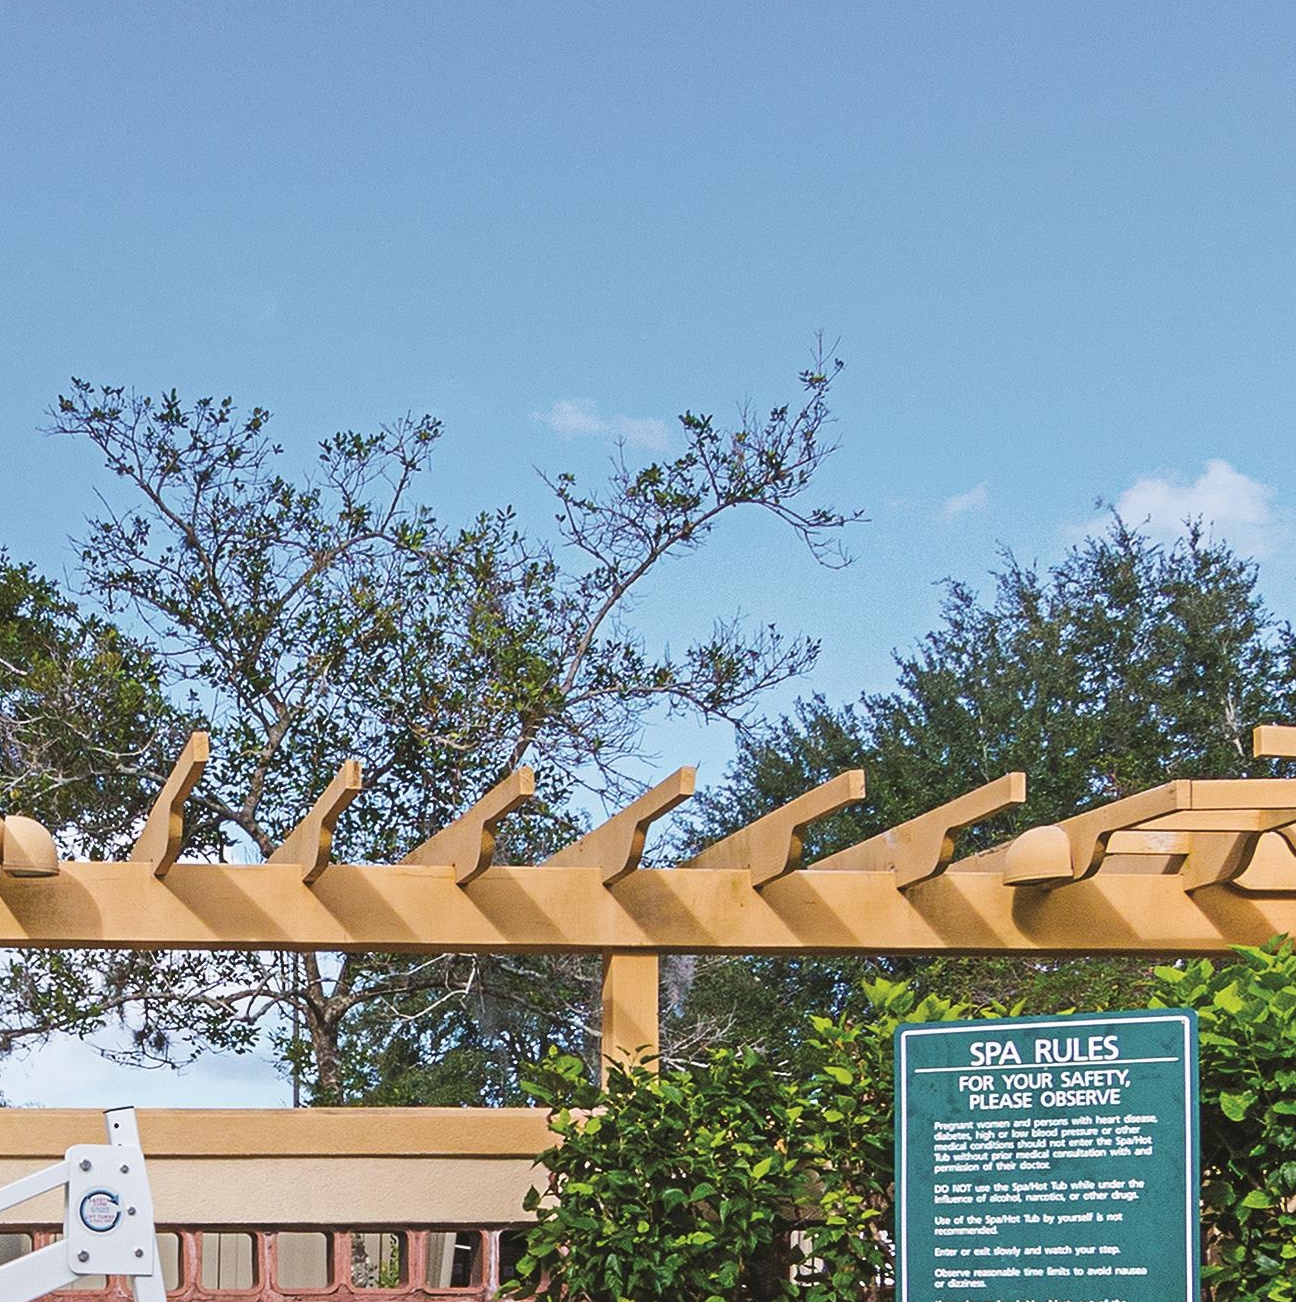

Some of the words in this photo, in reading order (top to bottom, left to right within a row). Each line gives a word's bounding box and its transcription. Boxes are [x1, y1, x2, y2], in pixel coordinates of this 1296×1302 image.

[969, 1040, 1022, 1067] SPA
[1034, 1035, 1119, 1064] RULES
[958, 1075, 995, 1092] FOR
[1001, 1072, 1053, 1090] YOUR
[1060, 1068, 1131, 1088] SAFETY,
[969, 1091, 1033, 1110] PLEASE
[1040, 1088, 1121, 1108] OBSERVE
[933, 1121, 974, 1132] Pregnant
[976, 1120, 1011, 1129] women
[1012, 1117, 1031, 1128] and
[1033, 1118, 1069, 1129] persons
[1071, 1115, 1093, 1125] with
[1095, 1115, 1121, 1125] heart
[975, 1129, 995, 1142] high
[997, 1131, 1009, 1139] or
[1011, 1129, 1029, 1139] low
[1031, 1127, 1059, 1138] blood
[1060, 1127, 1099, 1138] pressure
[1100, 1127, 1113, 1135] or
[1114, 1124, 1141, 1135] other
[933, 1141, 967, 1151] medical
[969, 1140, 1015, 1151] conditions
[1016, 1138, 1047, 1149] should
[1049, 1138, 1066, 1148] not
[1068, 1138, 1094, 1147] enter
[1095, 1136, 1113, 1146] the
[1114, 1135, 1153, 1146] Spa/Hot
[933, 1152, 951, 1162] Tub
[952, 1151, 989, 1161] without
[990, 1150, 1013, 1162] prior
[1015, 1149, 1050, 1159] medical
[1052, 1147, 1107, 1158] consultation
[1109, 1146, 1132, 1157] with
[1133, 1145, 1153, 1156] and
[933, 1162, 980, 1175] permission
[982, 1161, 993, 1171] of
[995, 1160, 1017, 1171] their
[933, 1184, 950, 1194] DO
[952, 1183, 973, 1193] NOT
[974, 1184, 991, 1193] use
[993, 1182, 1009, 1192] the
[1011, 1181, 1048, 1193] Spa/Hot
[1050, 1180, 1068, 1191] Tub
[1069, 1180, 1096, 1190] while
[1097, 1179, 1126, 1189] under
[1127, 1178, 1145, 1189] the
[934, 1194, 974, 1204] influence
[975, 1193, 987, 1203] of
[1068, 1192, 1080, 1201] or
[1082, 1190, 1109, 1201] other
[1110, 1189, 1139, 1202] drugs.
[934, 1216, 951, 1226] Use
[953, 1215, 964, 1225] of
[966, 1214, 983, 1225] the
[984, 1214, 1021, 1226] Spa/Hot
[1023, 1213, 1041, 1223] Tub
[1042, 1213, 1055, 1225] by
[1057, 1212, 1094, 1224] yourself
[1096, 1212, 1104, 1222] is
[1106, 1212, 1123, 1222] not
[934, 1247, 958, 1257] Enter
[960, 1248, 971, 1257] or
[973, 1246, 991, 1256] exit
[993, 1246, 1021, 1258] slowly
[1023, 1245, 1042, 1255] and
[1044, 1245, 1073, 1255] watch
[1074, 1246, 1097, 1256] your
[1098, 1245, 1121, 1256] step.
[934, 1268, 971, 1278] Observe
[973, 1267, 1021, 1277] reasonable
[1023, 1267, 1044, 1277] time
[1046, 1266, 1071, 1276] limits
[1072, 1267, 1085, 1276] to
[1086, 1265, 1112, 1276] avoid
[1114, 1267, 1148, 1276] nausea
[933, 1280, 945, 1289] or
